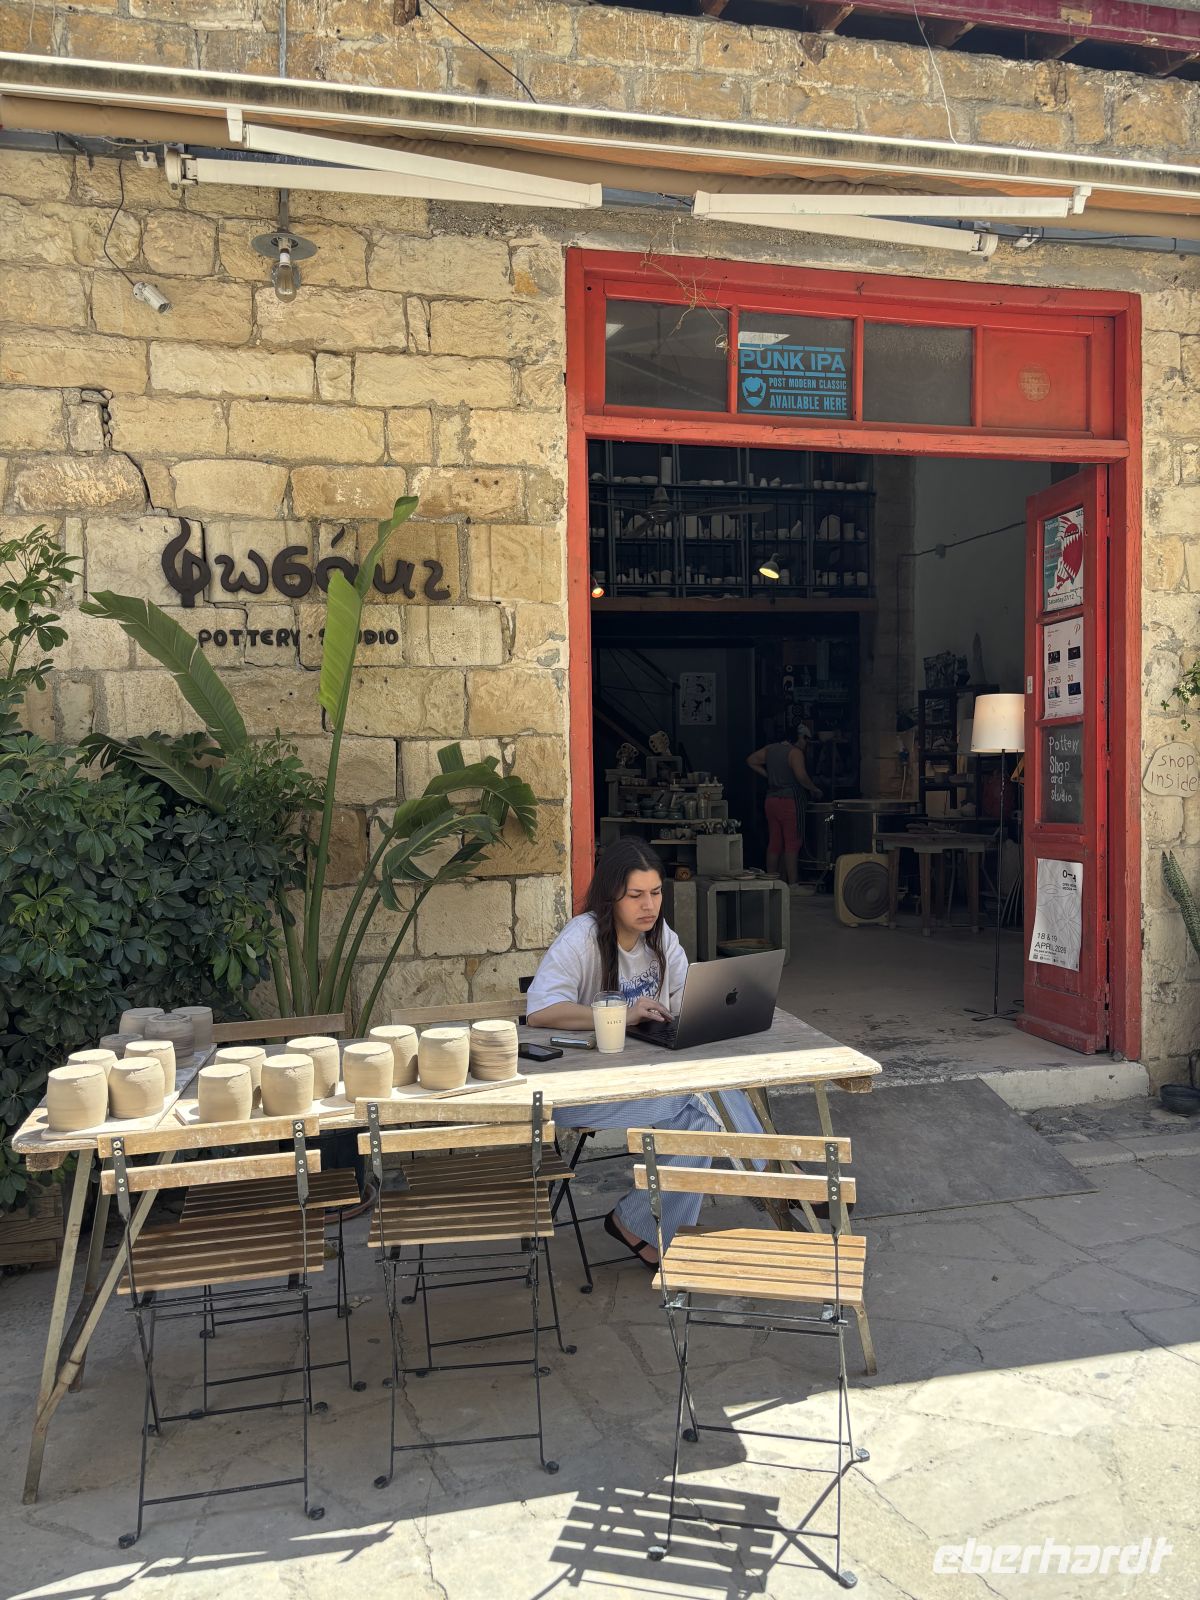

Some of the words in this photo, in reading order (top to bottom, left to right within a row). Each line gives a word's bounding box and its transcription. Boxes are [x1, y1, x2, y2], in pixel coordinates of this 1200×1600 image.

[739, 350, 805, 370] PUNK
[810, 352, 846, 372] IPA
[768, 377, 786, 387] POST
[788, 378, 817, 389] MODERN
[819, 379, 847, 390] CLASSIC
[769, 394, 820, 409] AVAILABLE
[823, 396, 847, 411] HERE
[198, 628, 300, 649] POTTERY
[1049, 755, 1071, 777] Shop
